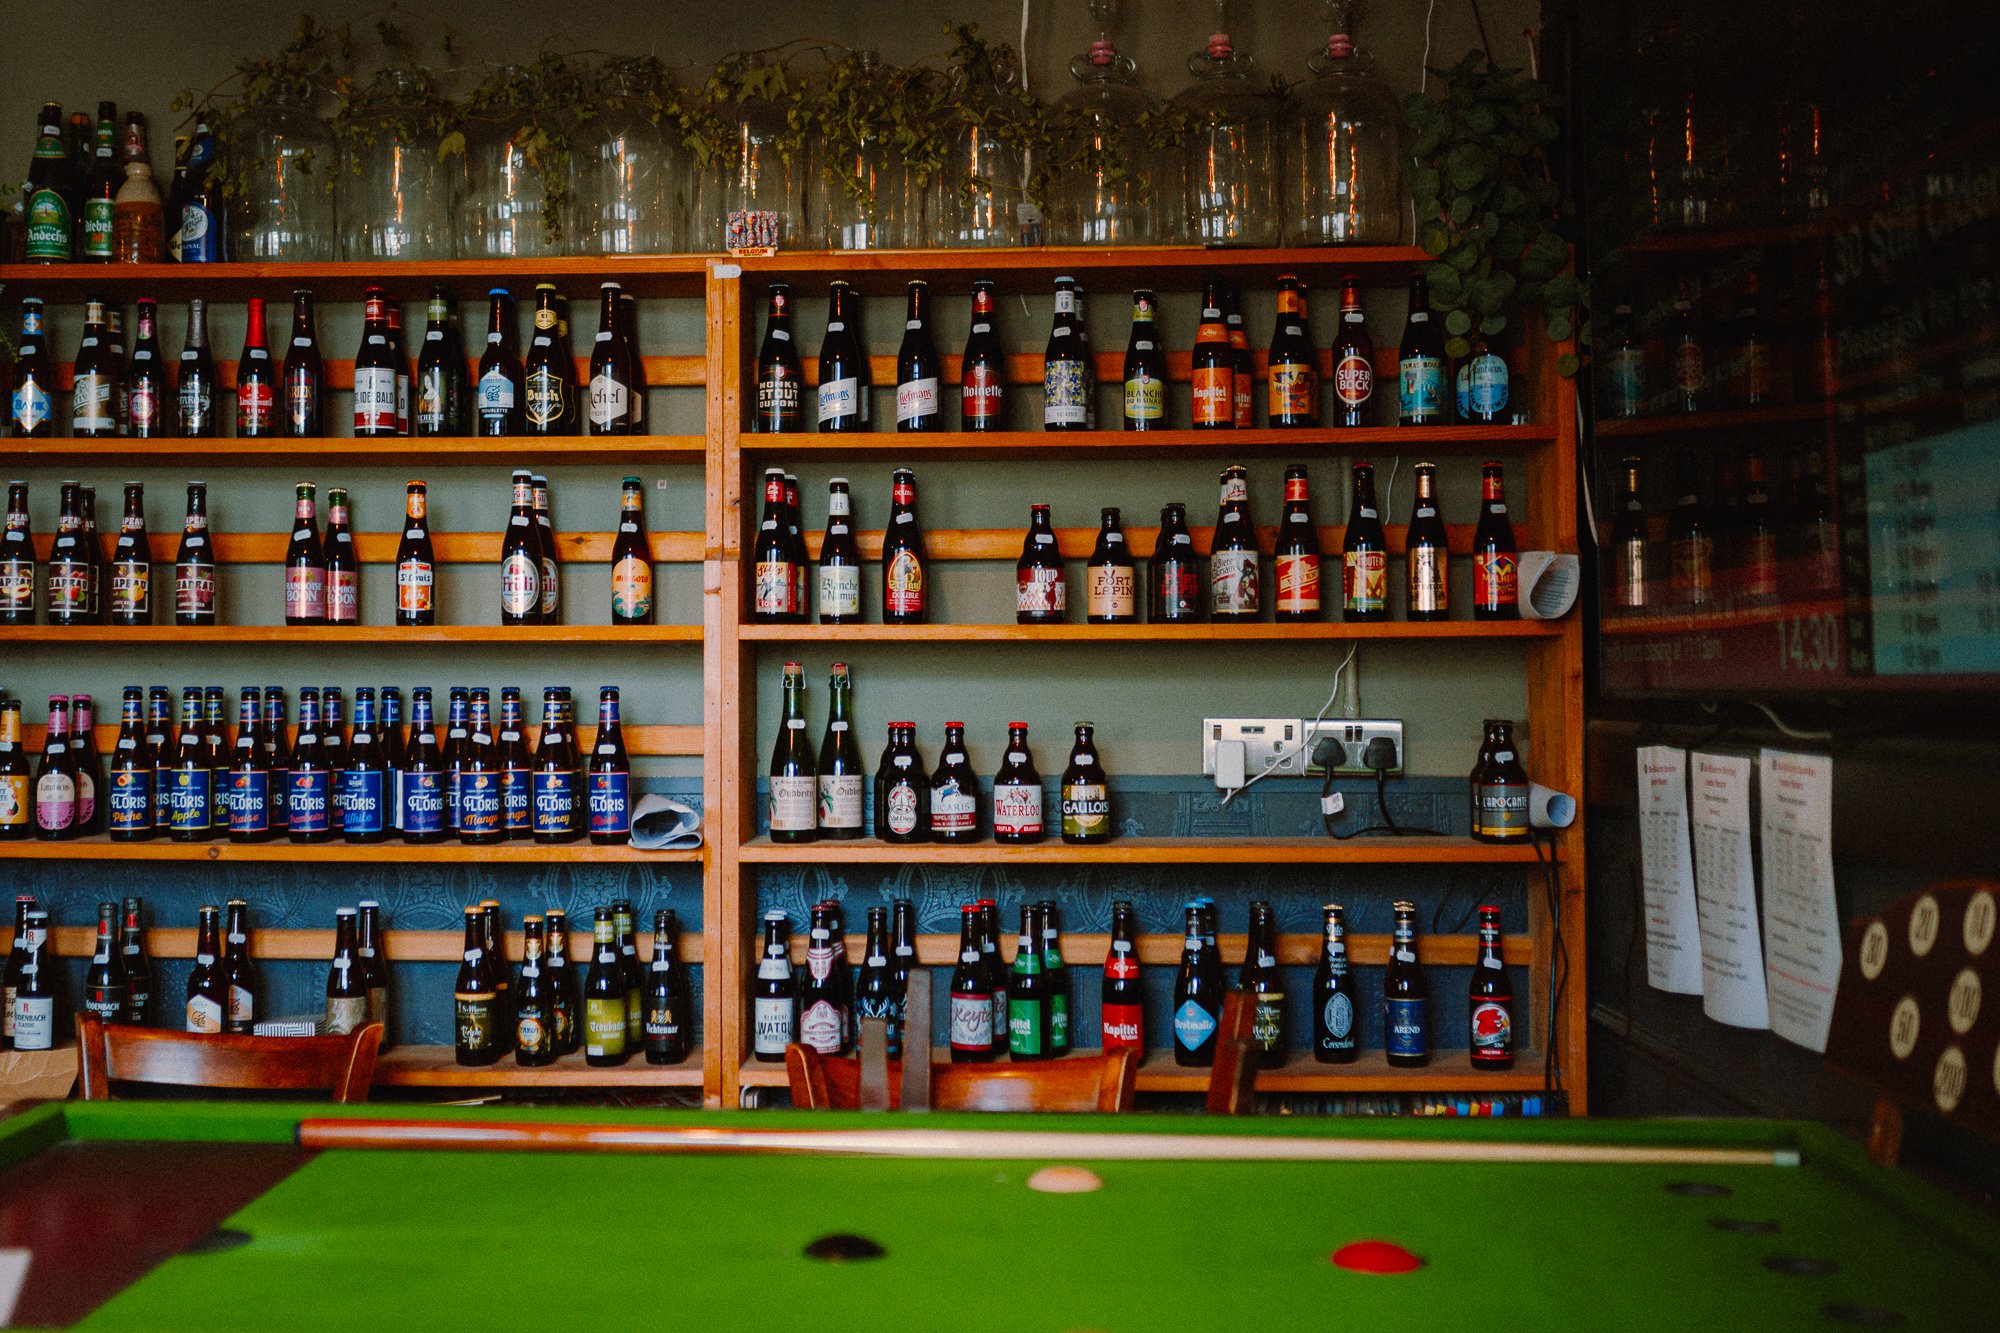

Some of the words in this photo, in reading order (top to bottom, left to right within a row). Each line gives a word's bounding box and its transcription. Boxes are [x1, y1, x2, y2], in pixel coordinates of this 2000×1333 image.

[27, 229, 68, 243] Andechs
[1339, 370, 1370, 380] SUPER
[760, 381, 798, 389] MONK'S
[1340, 380, 1370, 390] BOCK
[760, 389, 798, 401] STOUT
[963, 385, 1002, 398] Moinette
[360, 391, 394, 404] IDEBALD
[15, 399, 46, 411] BAVIK
[417, 414, 445, 422] CHESSE
[616, 575, 649, 583] MOGOZO
[1097, 576, 1131, 586] FORT
[287, 591, 318, 602] BOON
[996, 799, 1041, 817] WATERLOO
[538, 812, 571, 826] Honey
[15, 1013, 46, 1021] ODENBACH
[1394, 1025, 1420, 1034] AREND
